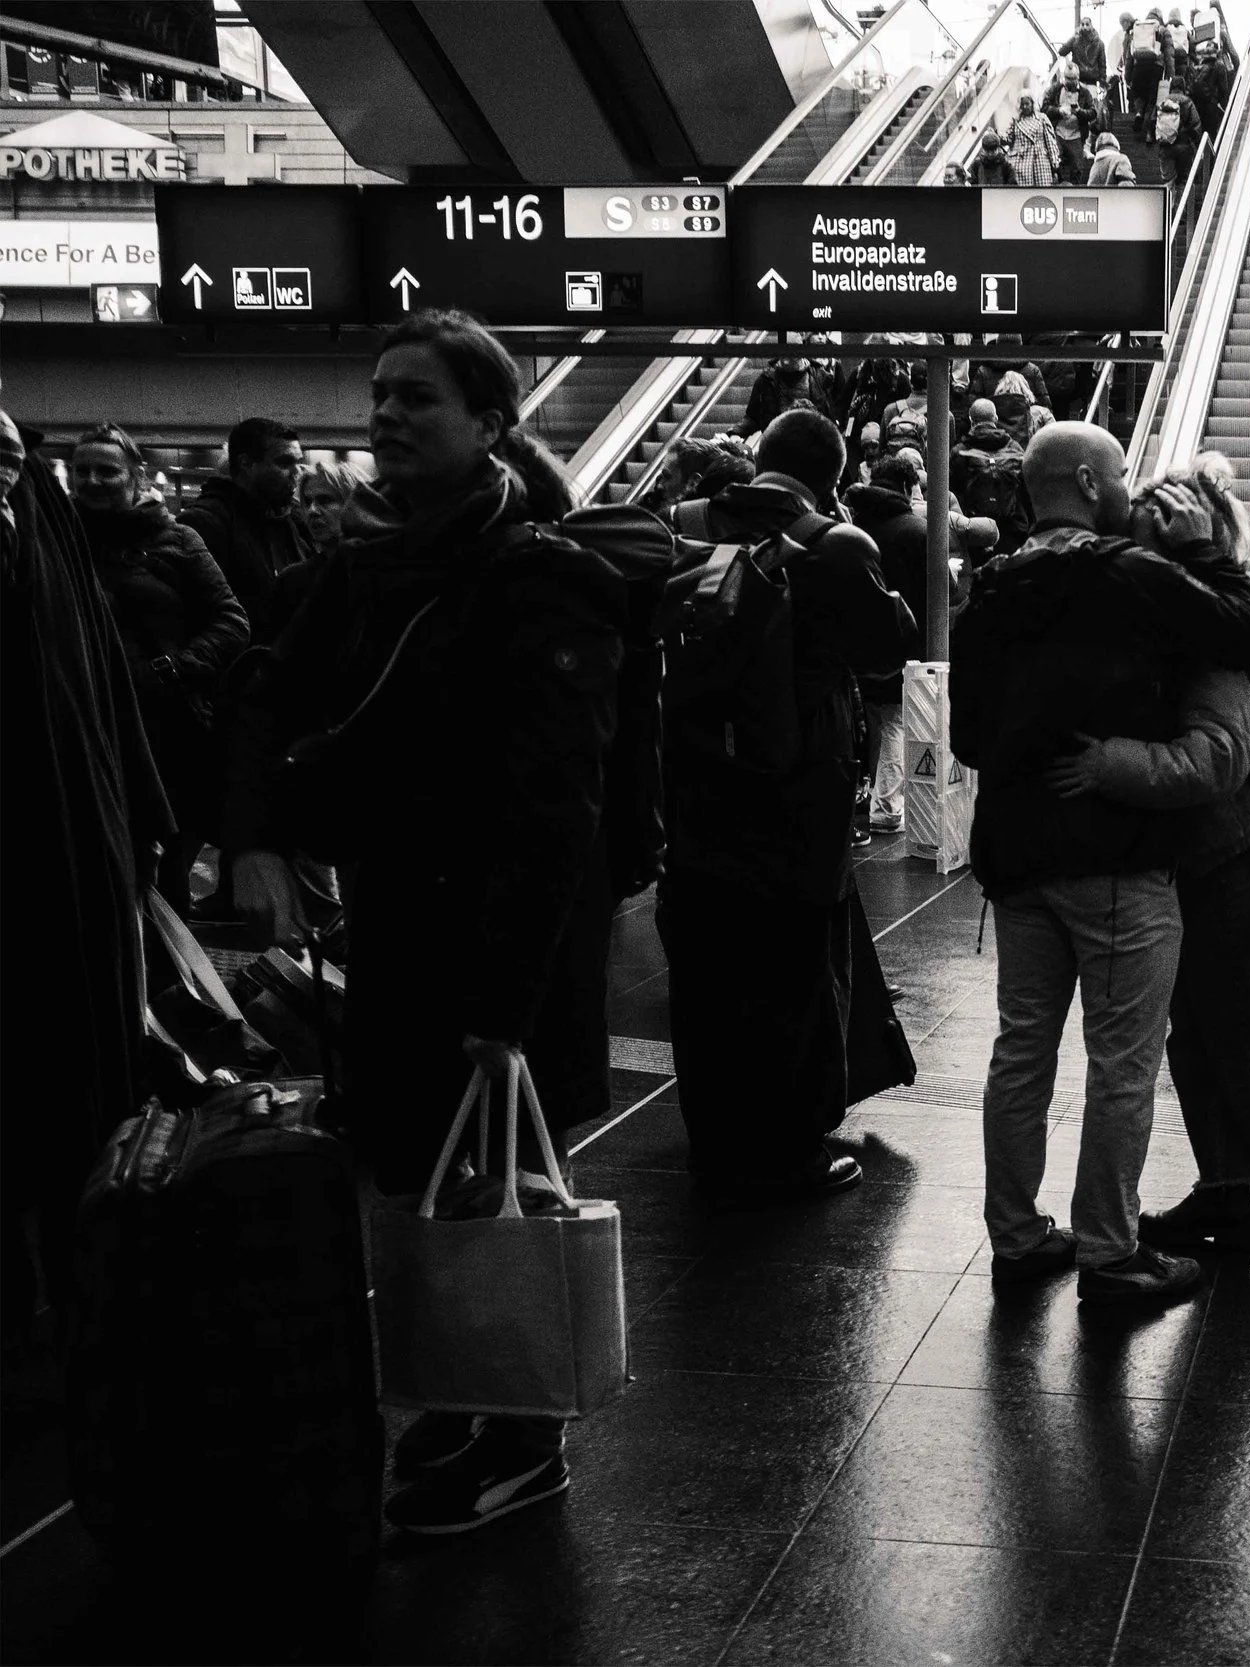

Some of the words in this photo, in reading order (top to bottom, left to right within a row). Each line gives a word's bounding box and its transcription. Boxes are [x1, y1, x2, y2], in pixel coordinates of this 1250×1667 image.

[0, 147, 187, 181] POTHEKE
[691, 196, 712, 211] S7
[436, 194, 543, 240] 11-16
[605, 196, 633, 232] S
[691, 216, 713, 231] S9
[1023, 207, 1056, 225] BUS
[1065, 207, 1097, 223] Tram
[812, 214, 896, 240] Ausgang
[56, 244, 94, 264] For
[101, 244, 118, 264] A
[126, 245, 160, 265] Be
[812, 242, 926, 266] Europaplatz
[812, 270, 957, 292] Invalidenstraße
[237, 293, 266, 305] Polizei
[276, 287, 304, 305] WC
[812, 306, 833, 319] exit
